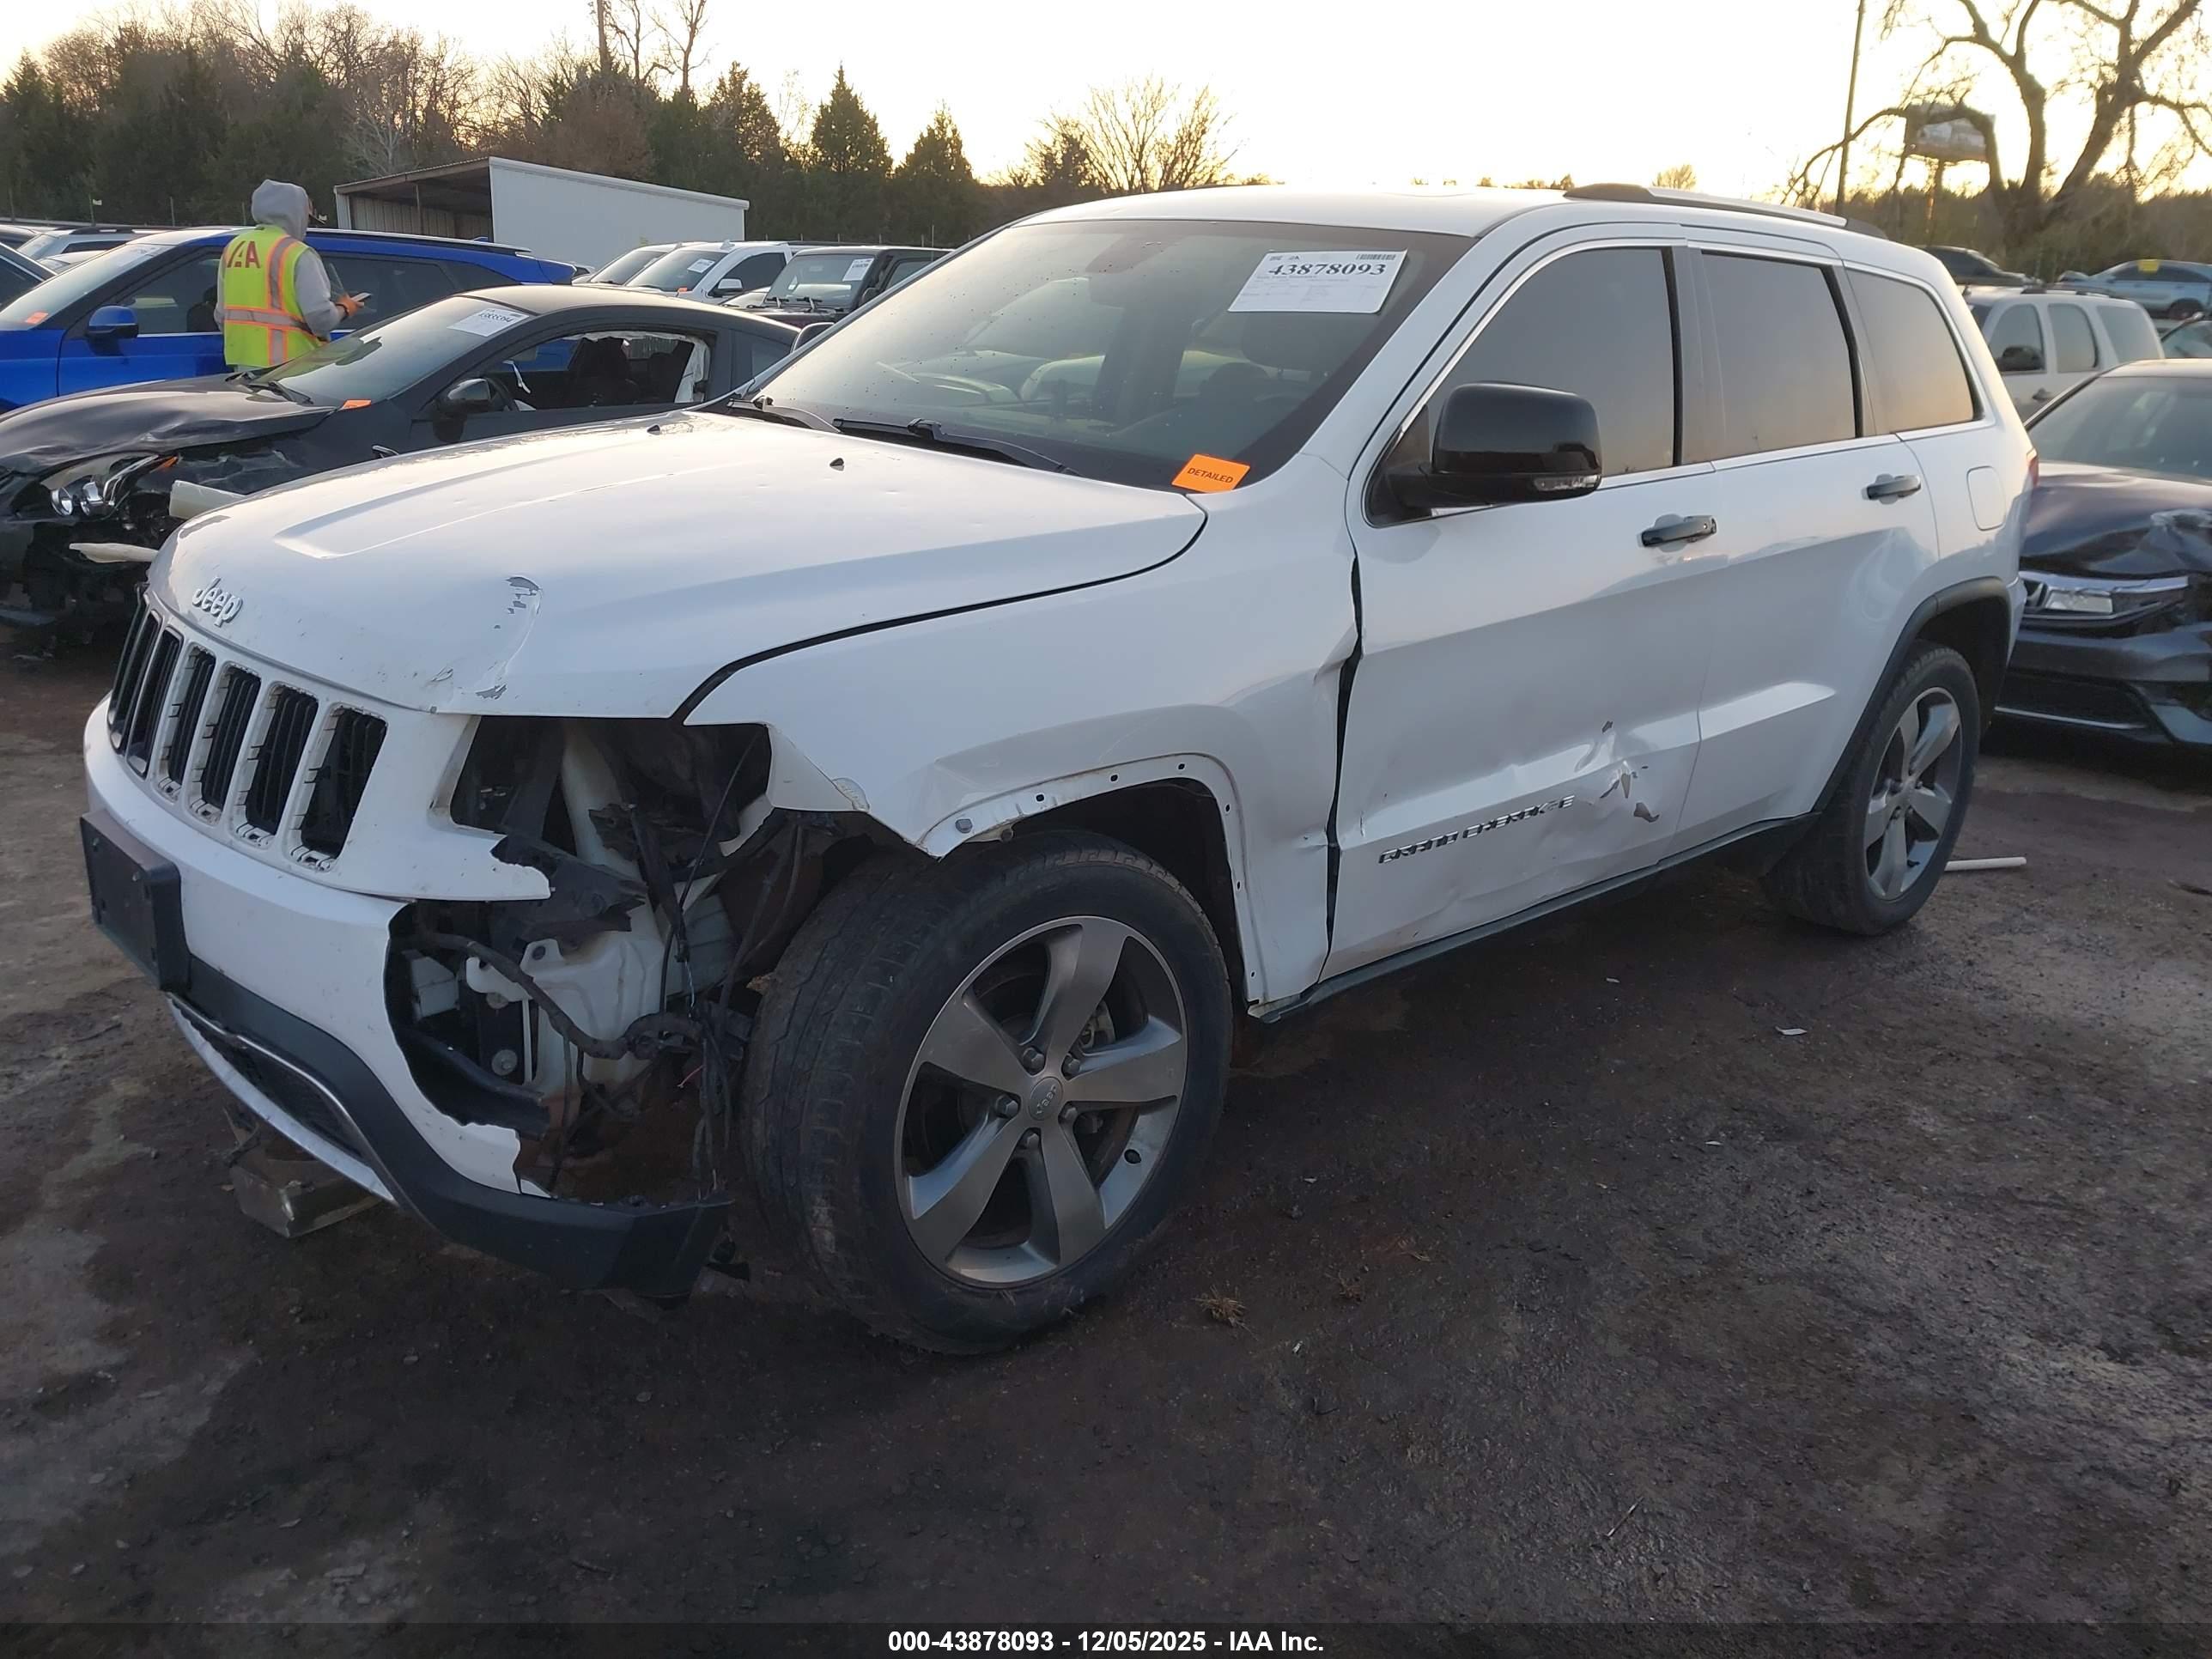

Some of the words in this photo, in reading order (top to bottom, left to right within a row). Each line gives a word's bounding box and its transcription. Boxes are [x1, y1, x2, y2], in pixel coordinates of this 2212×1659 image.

[1268, 264, 1387, 276] 43878093
[1187, 467, 1234, 483] DETAILED
[191, 576, 244, 629] Jeep
